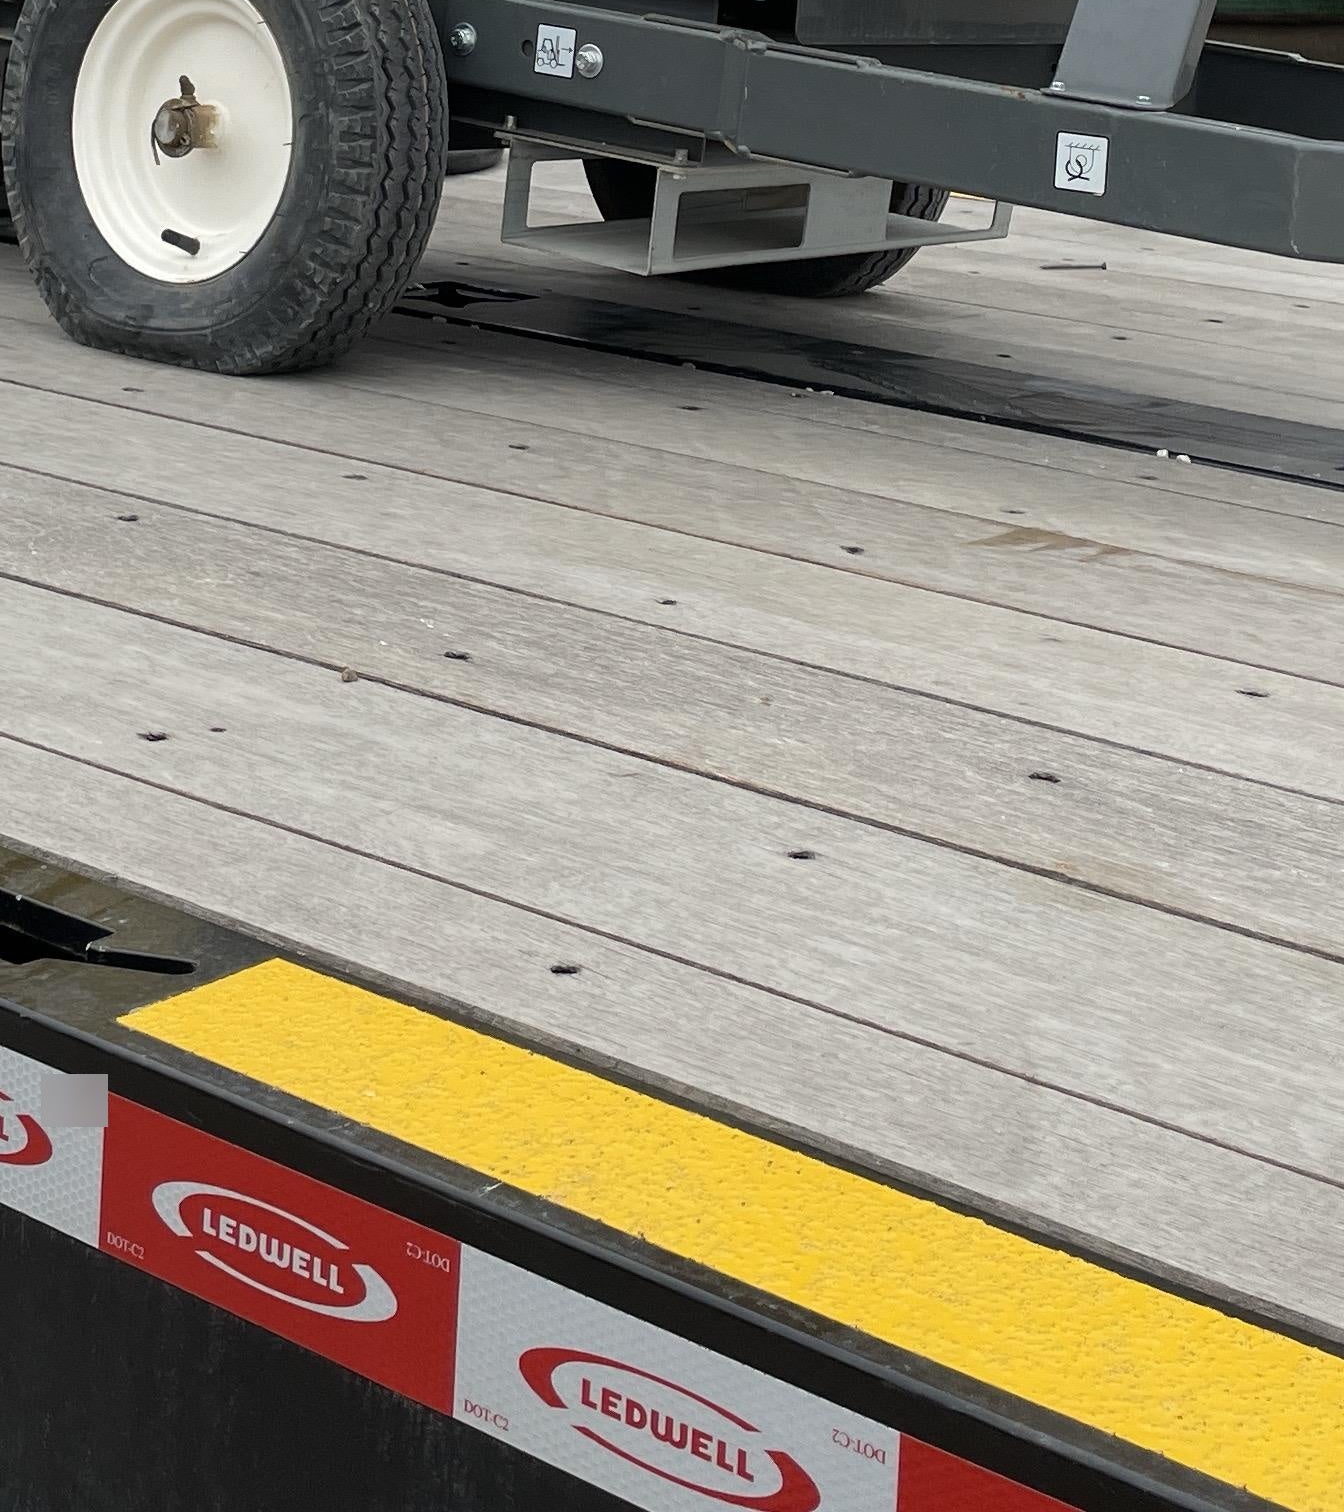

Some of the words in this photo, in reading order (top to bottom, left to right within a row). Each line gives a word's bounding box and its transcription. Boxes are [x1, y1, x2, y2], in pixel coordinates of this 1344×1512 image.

[106, 1231, 146, 1261] DOT-C2
[202, 1207, 344, 1295] LEDWELL
[405, 1241, 451, 1274] DOT-C2
[463, 1398, 511, 1432] DOT-C2
[581, 1377, 755, 1483] LEDWELL
[831, 1426, 887, 1465] DOT-C2
